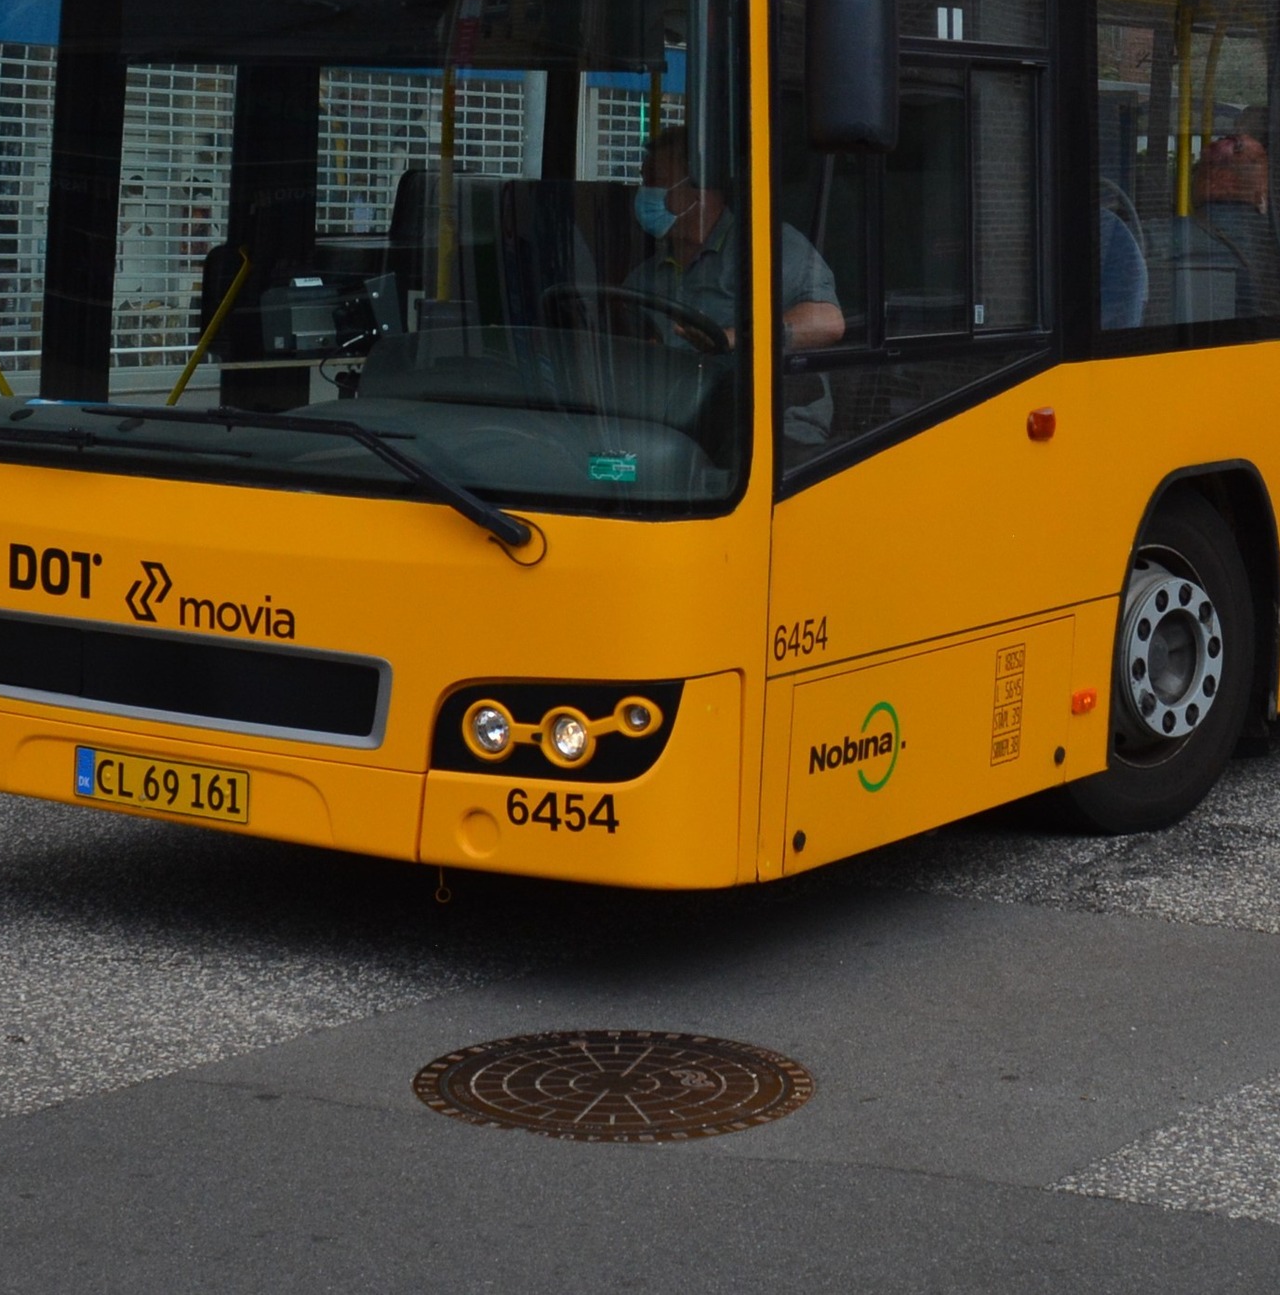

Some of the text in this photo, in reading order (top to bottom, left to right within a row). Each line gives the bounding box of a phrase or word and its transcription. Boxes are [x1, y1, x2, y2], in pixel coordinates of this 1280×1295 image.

[8, 543, 103, 600] DOT
[178, 593, 296, 640] movia
[773, 616, 828, 662] 6454
[808, 730, 894, 775] Nobina
[78, 759, 241, 814] DK CL 69 161
[506, 788, 620, 836] 6454
